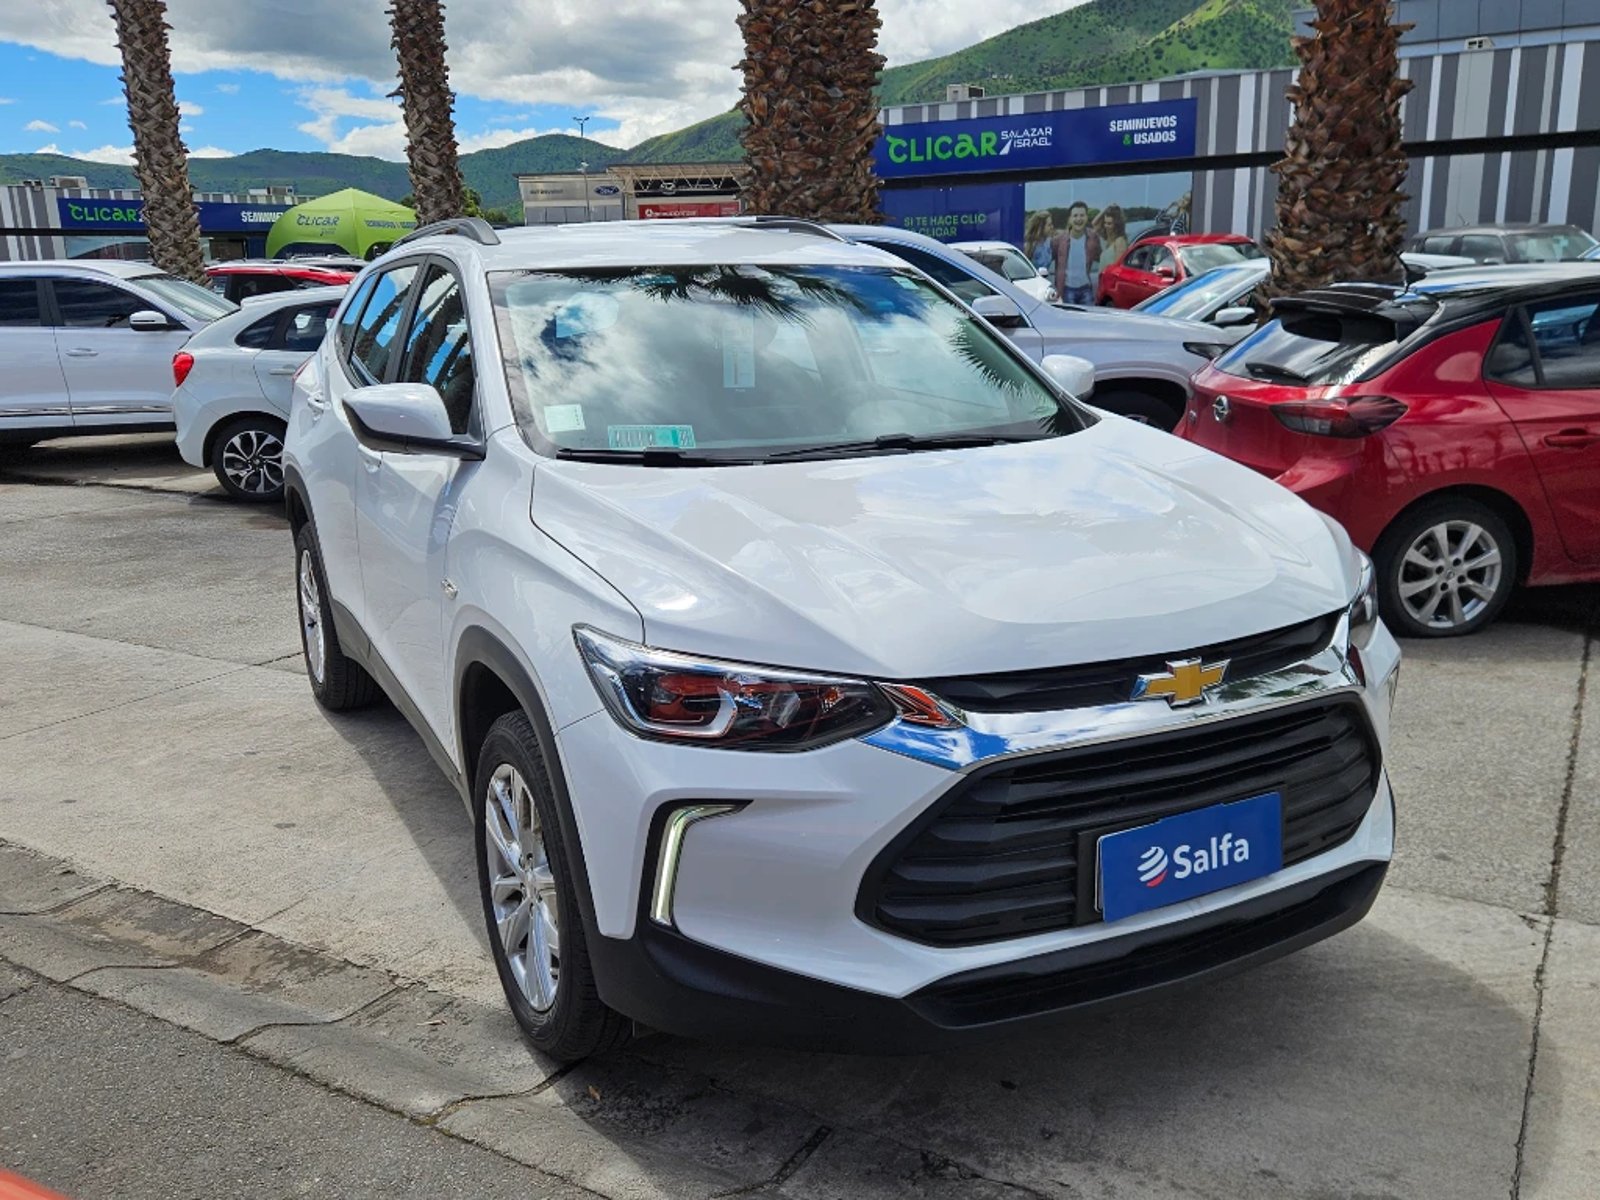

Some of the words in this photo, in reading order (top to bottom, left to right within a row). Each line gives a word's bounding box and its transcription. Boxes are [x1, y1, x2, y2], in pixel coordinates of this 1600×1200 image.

[1109, 115, 1177, 132] SEMINUEVOS
[1001, 126, 1052, 140] SALAZAR
[1134, 130, 1176, 144] USADOS
[1013, 137, 1052, 148] ISRAEL
[904, 216, 913, 227] SI
[915, 216, 927, 226] TE
[930, 215, 958, 226] HACE
[960, 213, 987, 225] CLIC
[919, 226, 957, 237] CLICAR
[1173, 833, 1249, 879] Salfa
